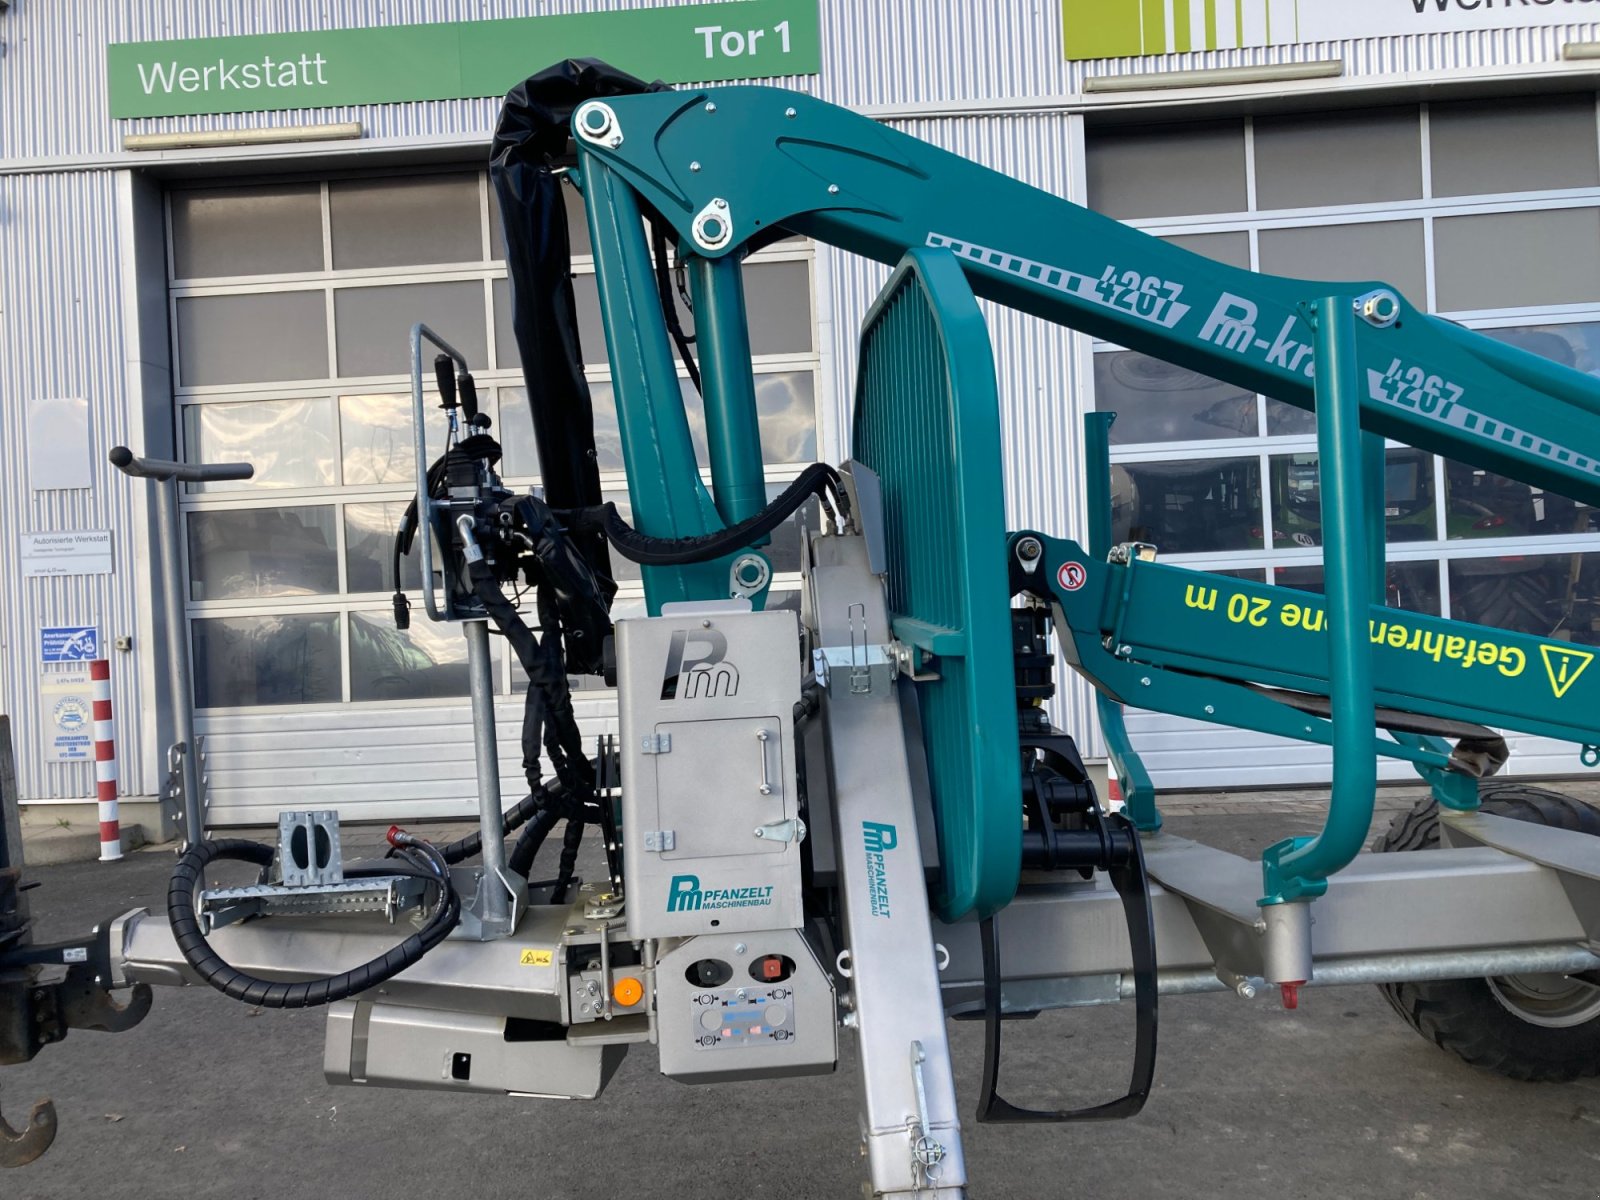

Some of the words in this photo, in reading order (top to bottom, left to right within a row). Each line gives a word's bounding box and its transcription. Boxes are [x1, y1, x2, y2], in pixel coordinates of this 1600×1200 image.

[694, 25, 765, 58] Tor
[773, 20, 790, 53] 1
[137, 53, 328, 94] Werkstatt
[1095, 265, 1184, 323] 4267
[1379, 357, 1464, 419] 4267
[33, 536, 73, 545] Autorisierte
[74, 534, 109, 543] Werkstatt
[1184, 584, 1218, 611] m
[1227, 593, 1271, 627] 20
[703, 886, 773, 901] PFANZELT
[866, 852, 878, 916] MASCHINENBAU
[873, 853, 890, 918] PFANZELT
[702, 899, 771, 909] MASCHINENBAU
